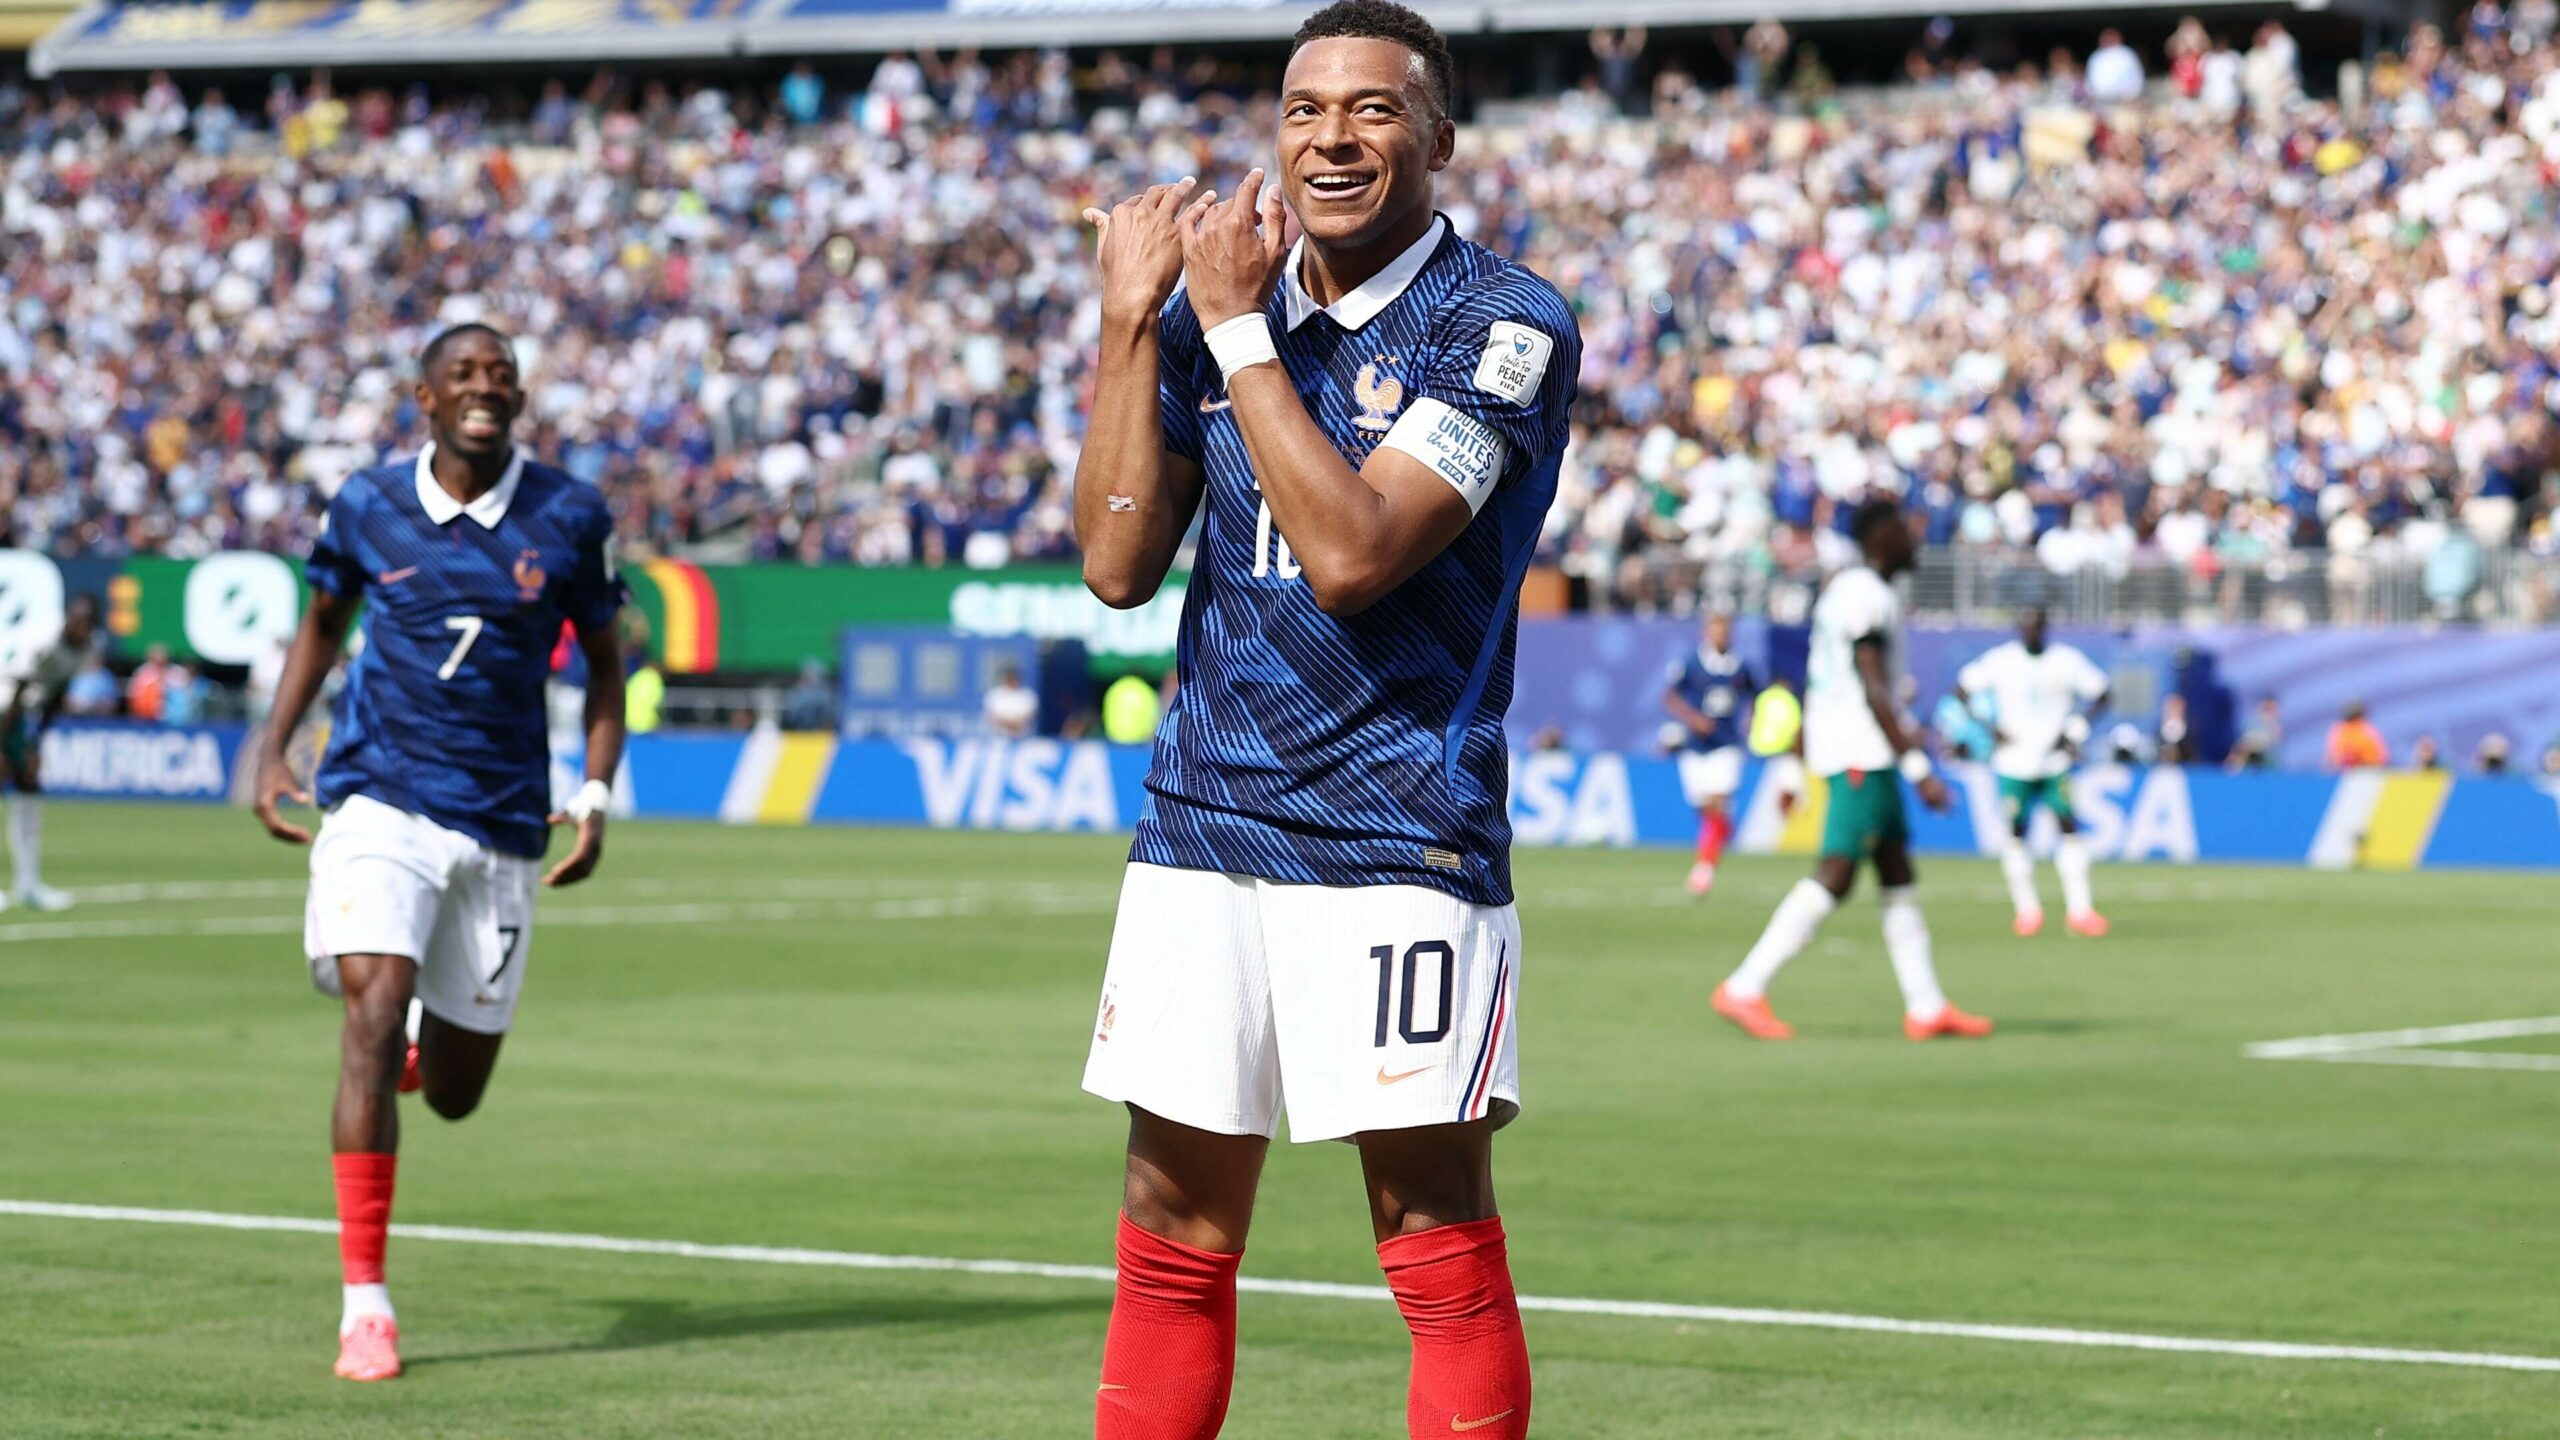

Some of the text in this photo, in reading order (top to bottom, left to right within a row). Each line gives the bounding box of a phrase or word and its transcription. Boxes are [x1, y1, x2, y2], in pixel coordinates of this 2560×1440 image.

[1497, 364, 1526, 387] PEACE
[1500, 380, 1515, 393] FIFA
[1520, 360, 1531, 373] For
[1426, 430, 1489, 488] the World
[1438, 415, 1494, 470] UNITES
[1440, 459, 1464, 484] FIFA
[438, 616, 483, 680] 7
[905, 737, 1119, 832] VISA
[1509, 752, 1637, 845] SA
[489, 926, 520, 984] 7
[1370, 939, 1454, 1048] 10
